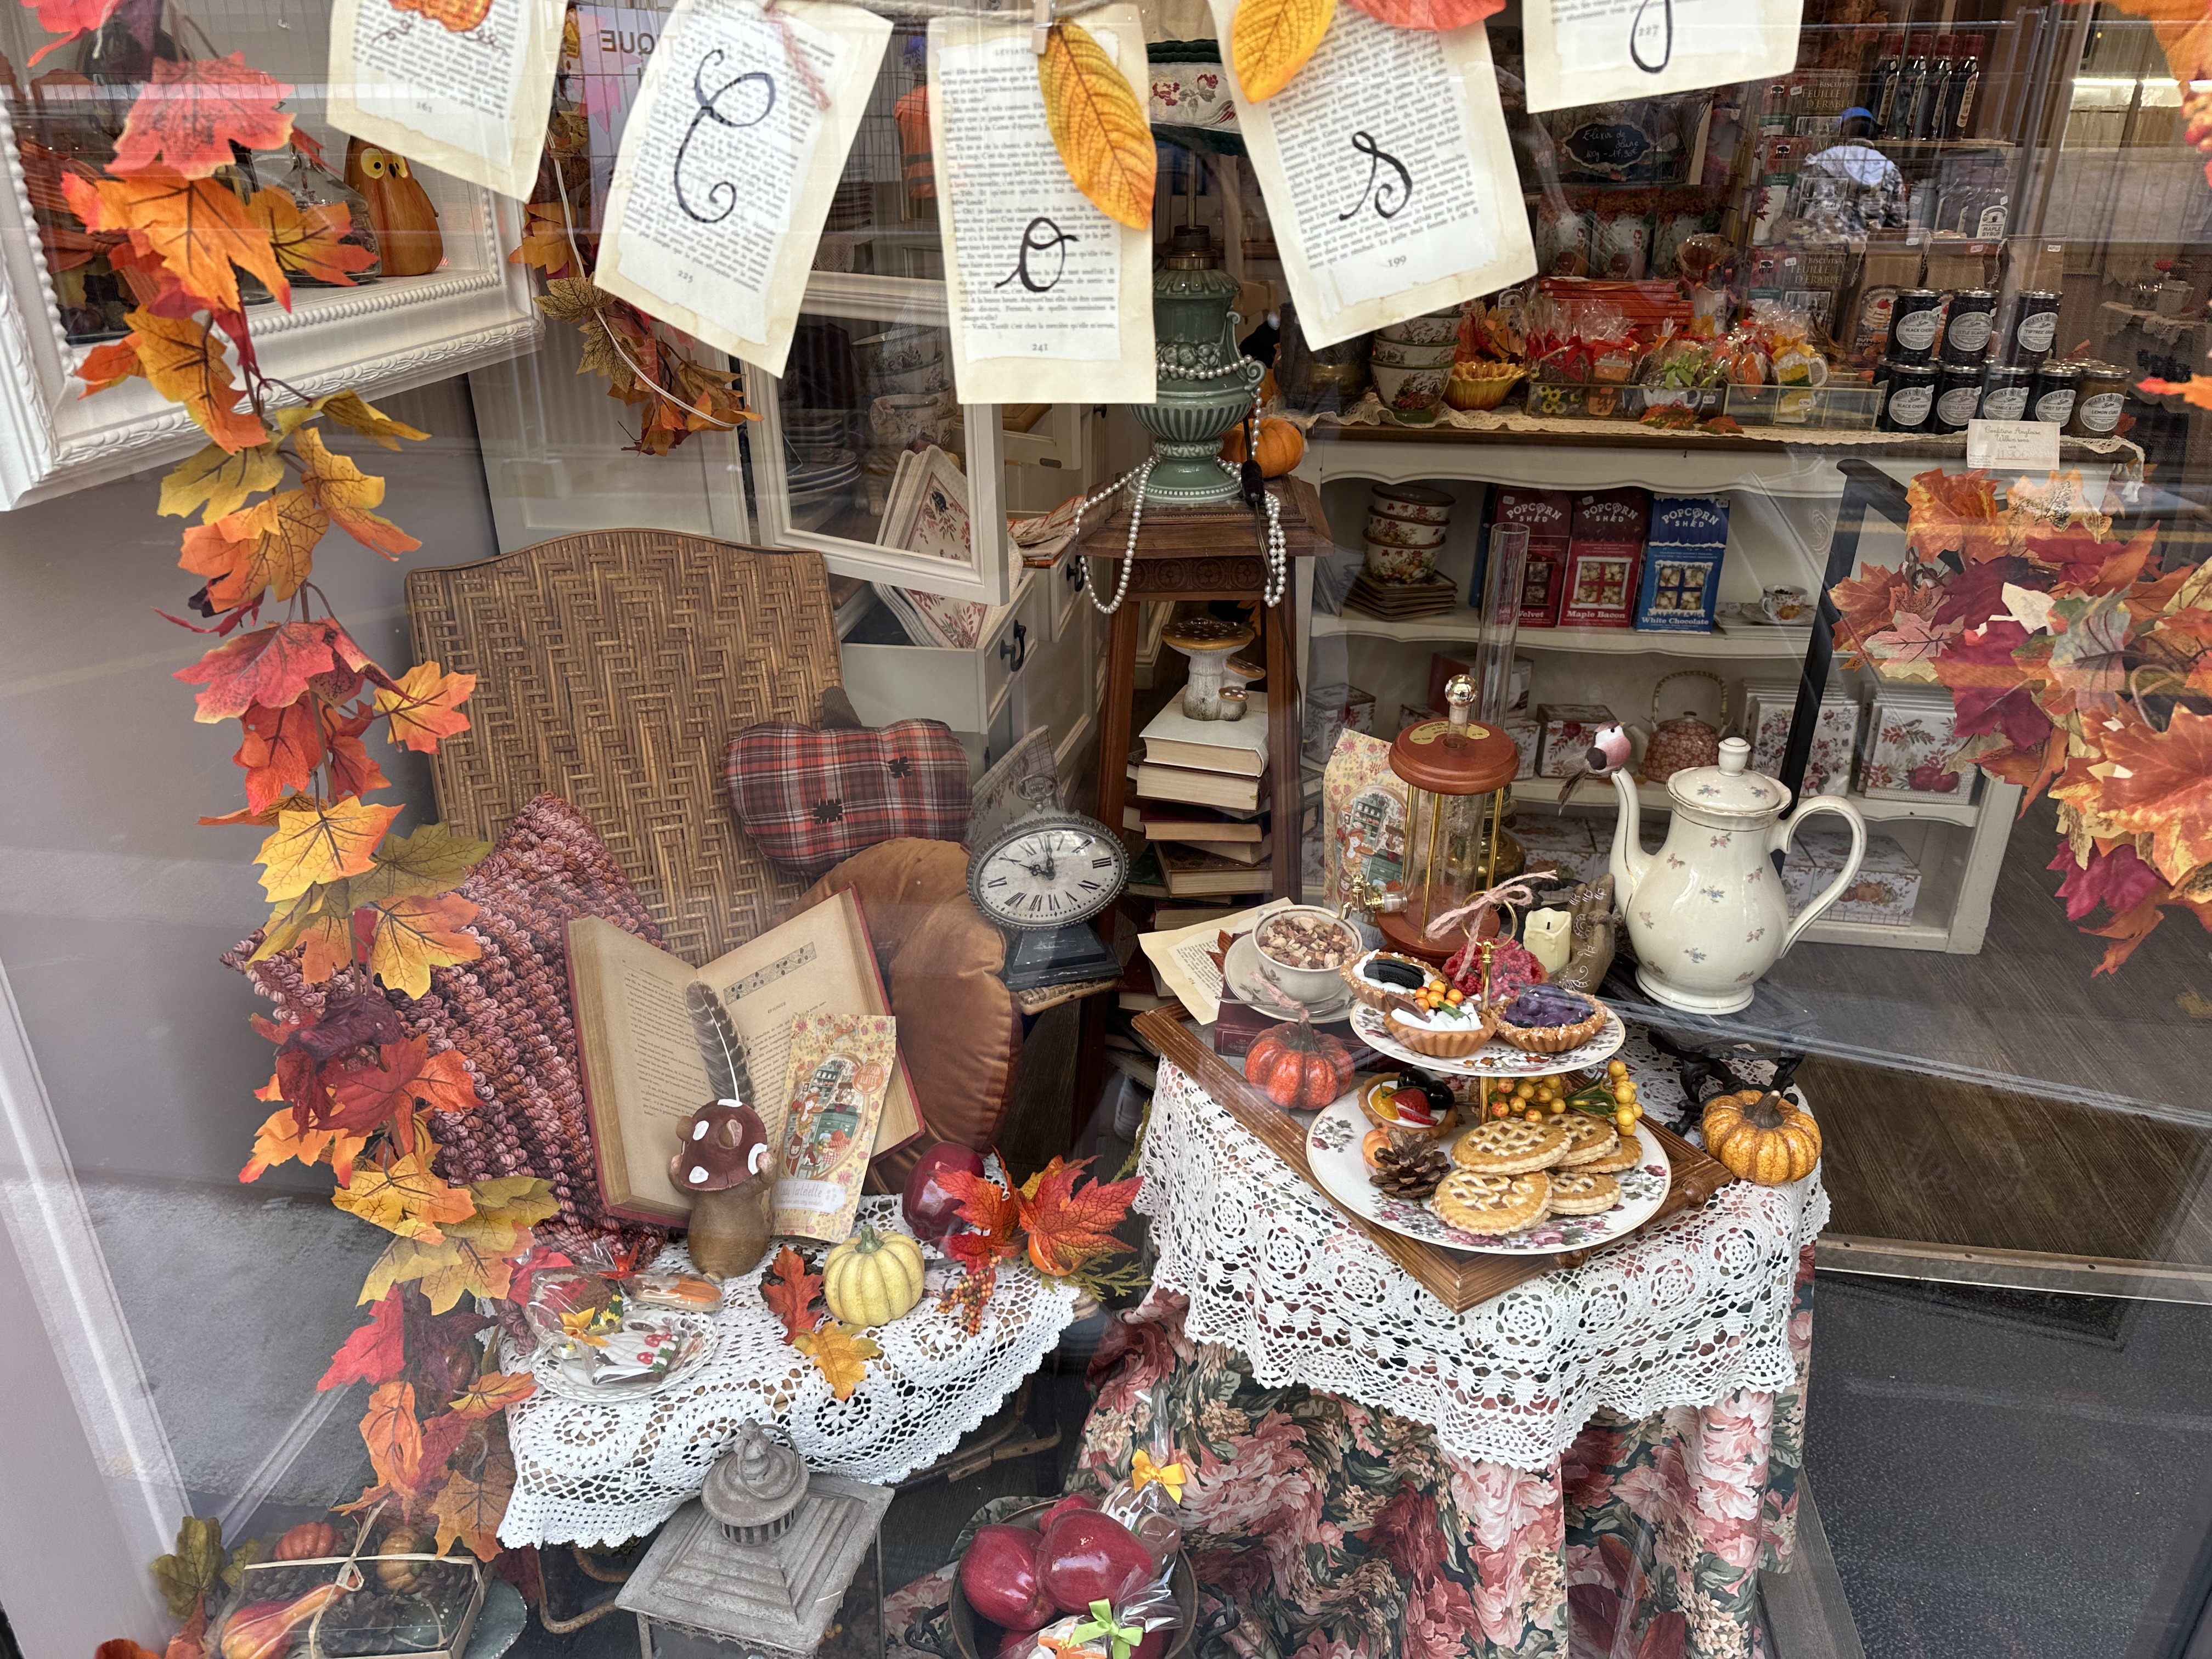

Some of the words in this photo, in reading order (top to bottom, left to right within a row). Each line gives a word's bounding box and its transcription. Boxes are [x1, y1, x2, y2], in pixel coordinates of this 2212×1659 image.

[1802, 89, 1841, 98] FEUILLE
[1617, 129, 1627, 138] de
[1387, 255, 1407, 268] 199
[677, 269, 693, 283] 225
[1032, 343, 1048, 352] 241
[1506, 503, 1562, 520] POPCORN
[1583, 503, 1639, 520] POPCORN
[1661, 508, 1720, 526] POPCORN
[1567, 610, 1595, 619] Maple
[1669, 617, 1709, 625] Chocolate
[1092, 857, 1112, 869] III
[793, 1182, 823, 1198] Tartelette
